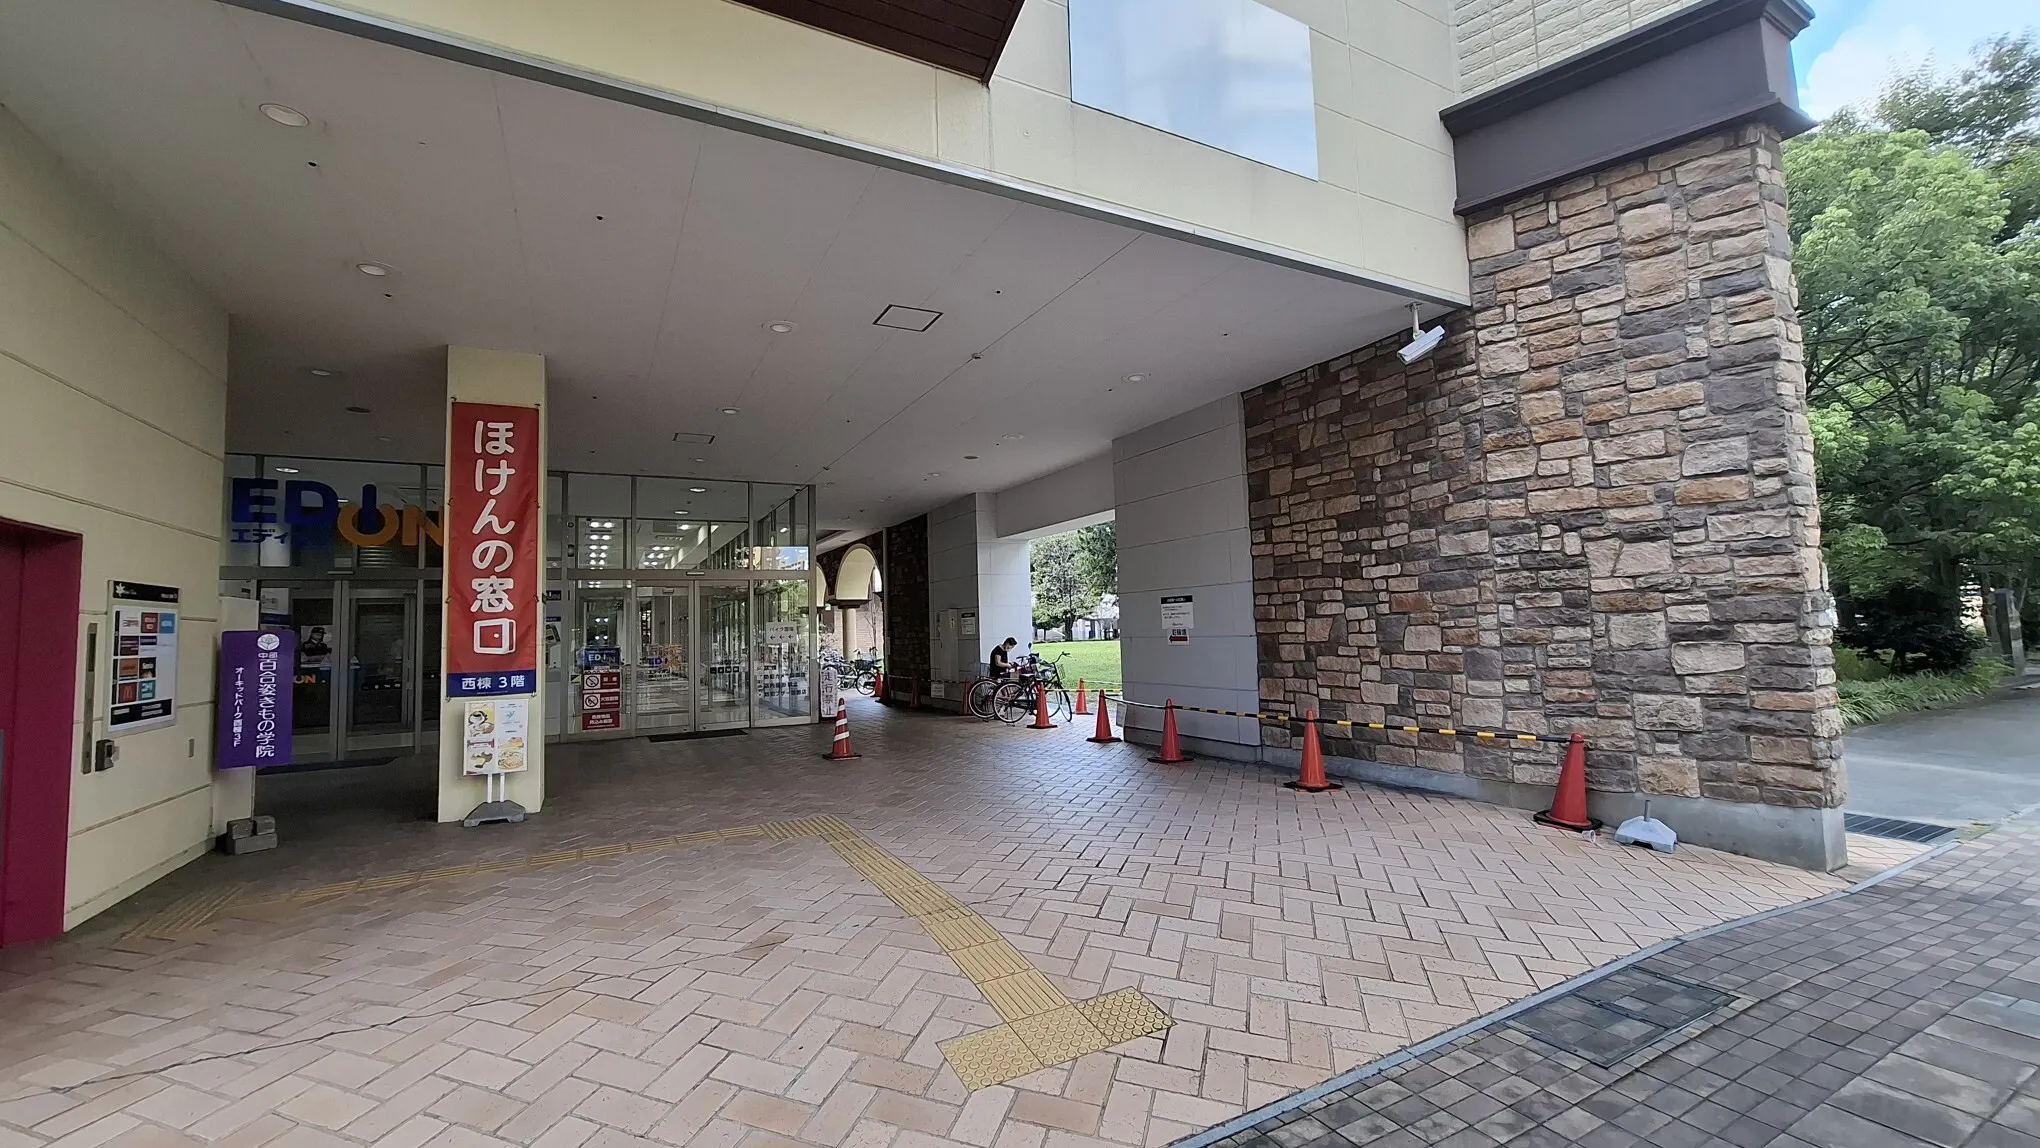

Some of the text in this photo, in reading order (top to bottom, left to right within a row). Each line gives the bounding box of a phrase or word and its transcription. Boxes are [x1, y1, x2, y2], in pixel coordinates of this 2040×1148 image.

[471, 420, 516, 655] ほけんの窓口
[462, 675, 525, 690] 西棟 3階
